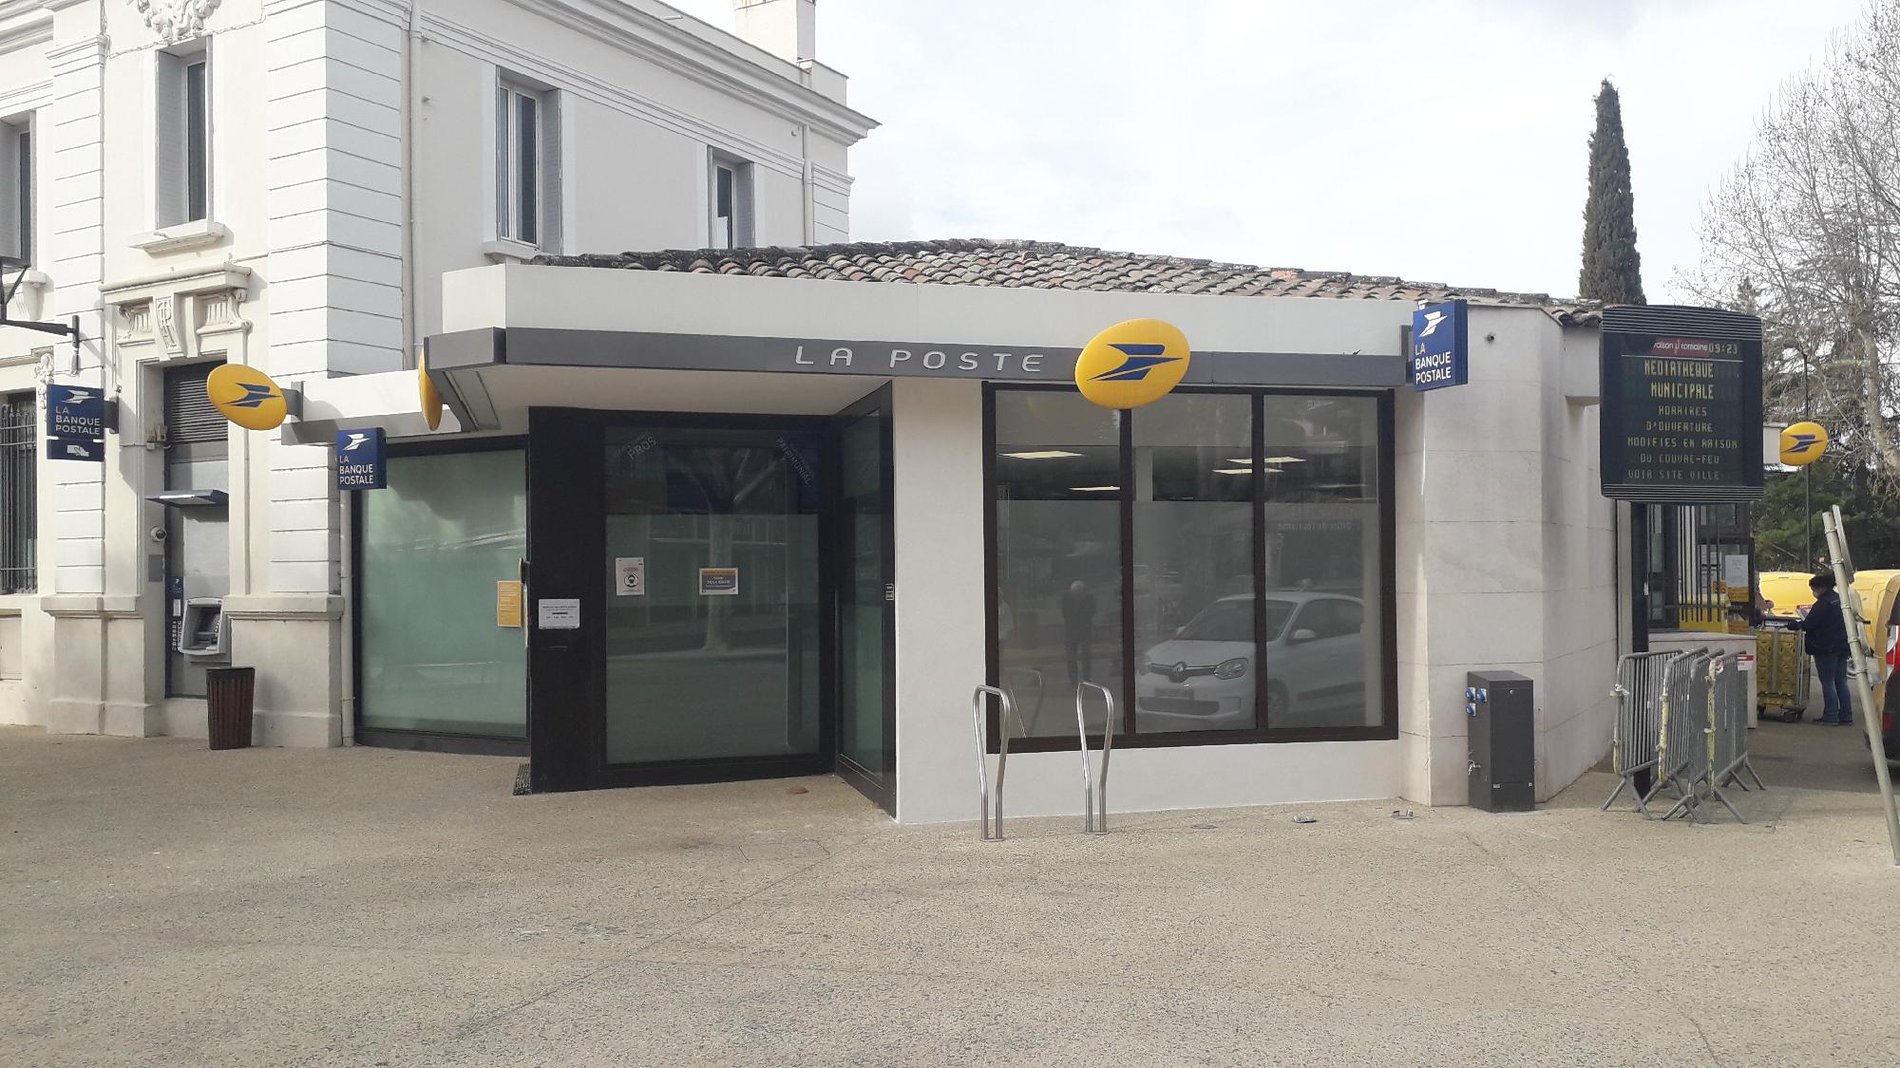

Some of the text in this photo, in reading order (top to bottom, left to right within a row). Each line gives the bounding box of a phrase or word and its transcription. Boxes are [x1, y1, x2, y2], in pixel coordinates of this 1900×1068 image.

[1415, 342, 1426, 355] LA
[1681, 343, 1708, 352] romaine
[1708, 343, 1738, 354] 09:23
[795, 345, 1044, 372] LA POSTE
[1415, 351, 1451, 369] BANQUE
[1644, 359, 1714, 378] MEDIATHEQUE
[1415, 366, 1452, 385] POSTALE
[1651, 381, 1714, 399] MUNICIPALE
[55, 405, 70, 414] LA
[1658, 405, 1708, 417] HORAIRES
[55, 414, 101, 427] BANQUE
[55, 424, 101, 435] POSTALE
[1646, 421, 1713, 433] D'OUVERTURE
[627, 436, 657, 460] PROS
[1628, 437, 1738, 449] MODIFIES EN RAISON
[339, 455, 350, 464] LA
[1640, 453, 1720, 464] DU COUVRE-FEU
[339, 463, 374, 475] BANQUE
[1628, 469, 1720, 481] VOIR SITE VILLE
[339, 474, 374, 485] POSTALE
